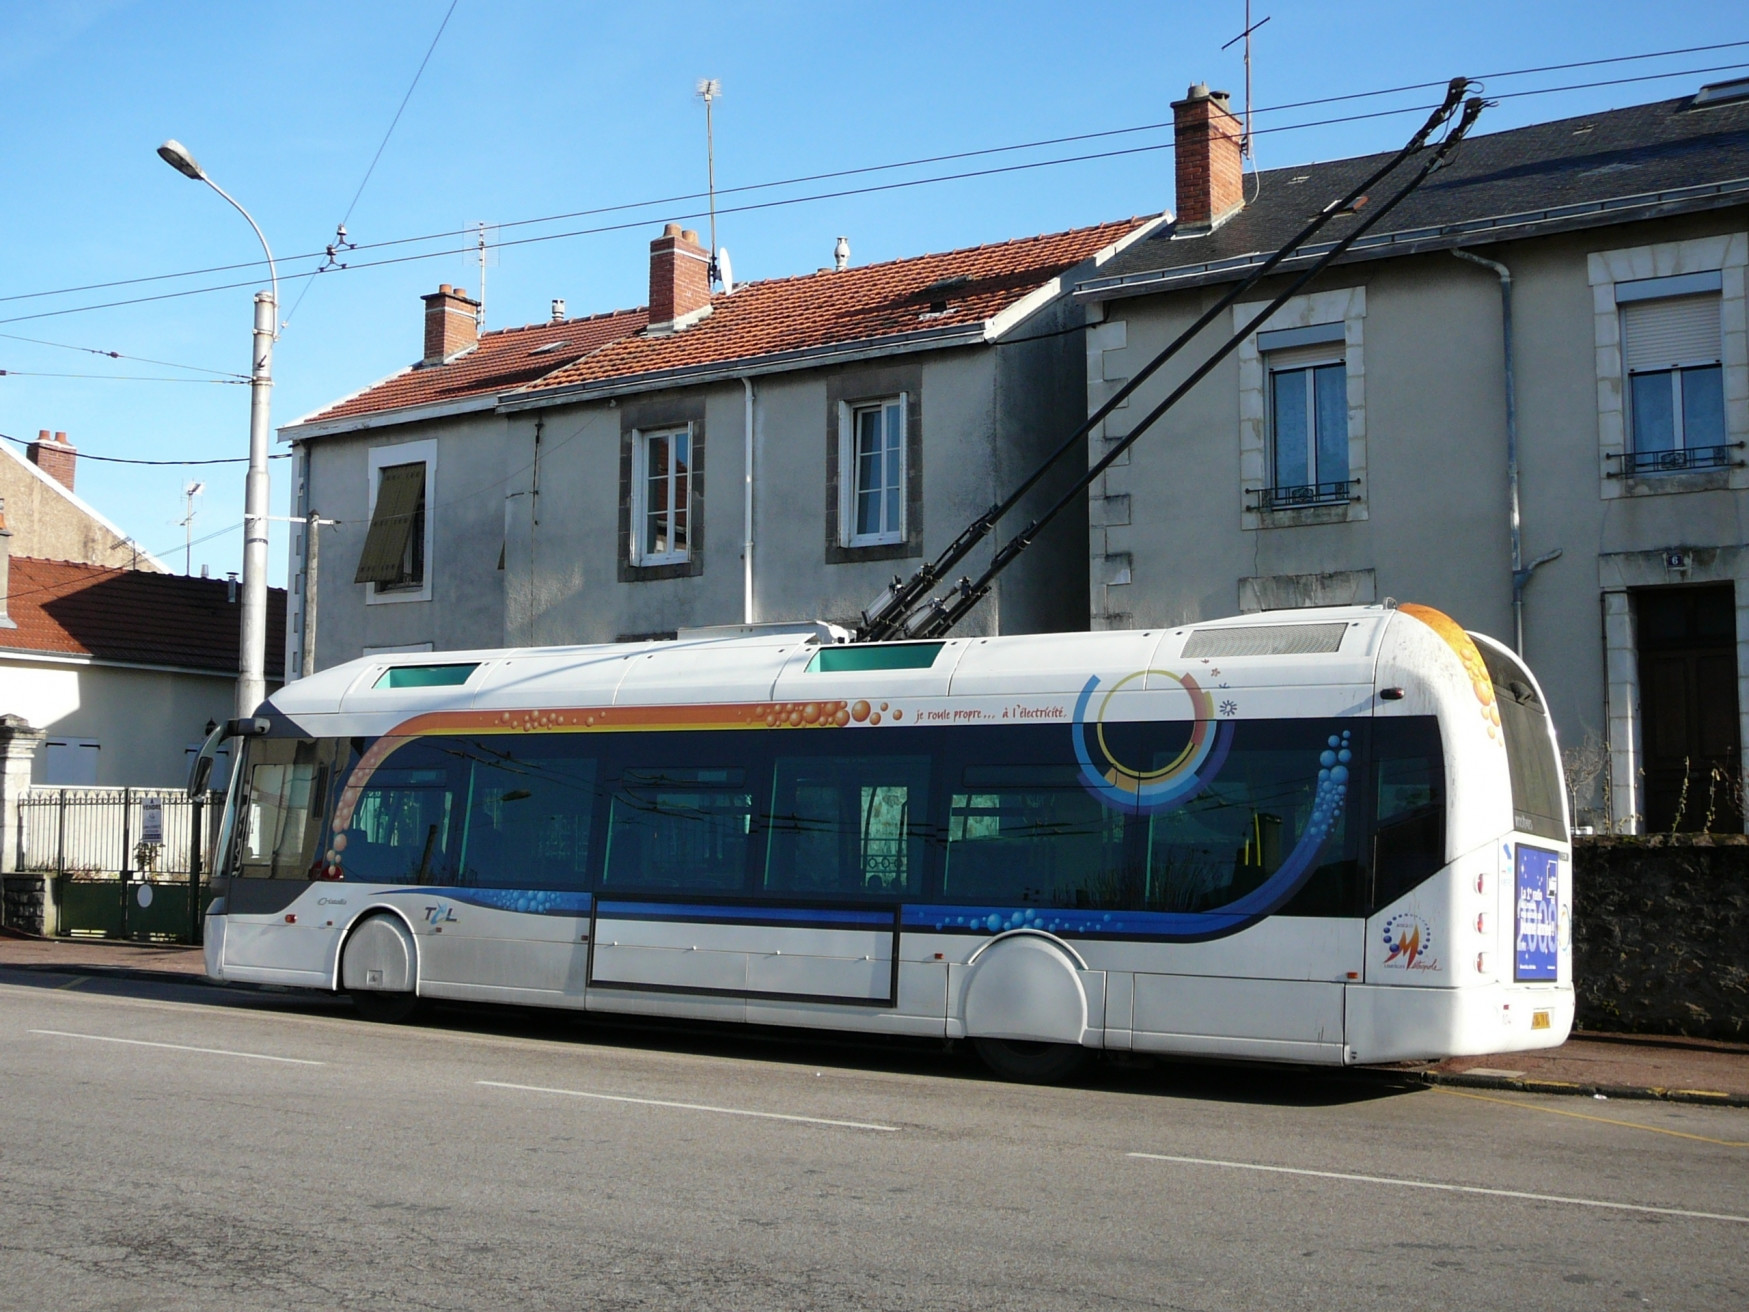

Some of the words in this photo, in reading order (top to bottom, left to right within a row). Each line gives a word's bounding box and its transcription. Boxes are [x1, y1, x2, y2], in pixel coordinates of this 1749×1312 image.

[1671, 556, 1678, 565] 6
[914, 709, 924, 724] je
[927, 709, 950, 720] roule
